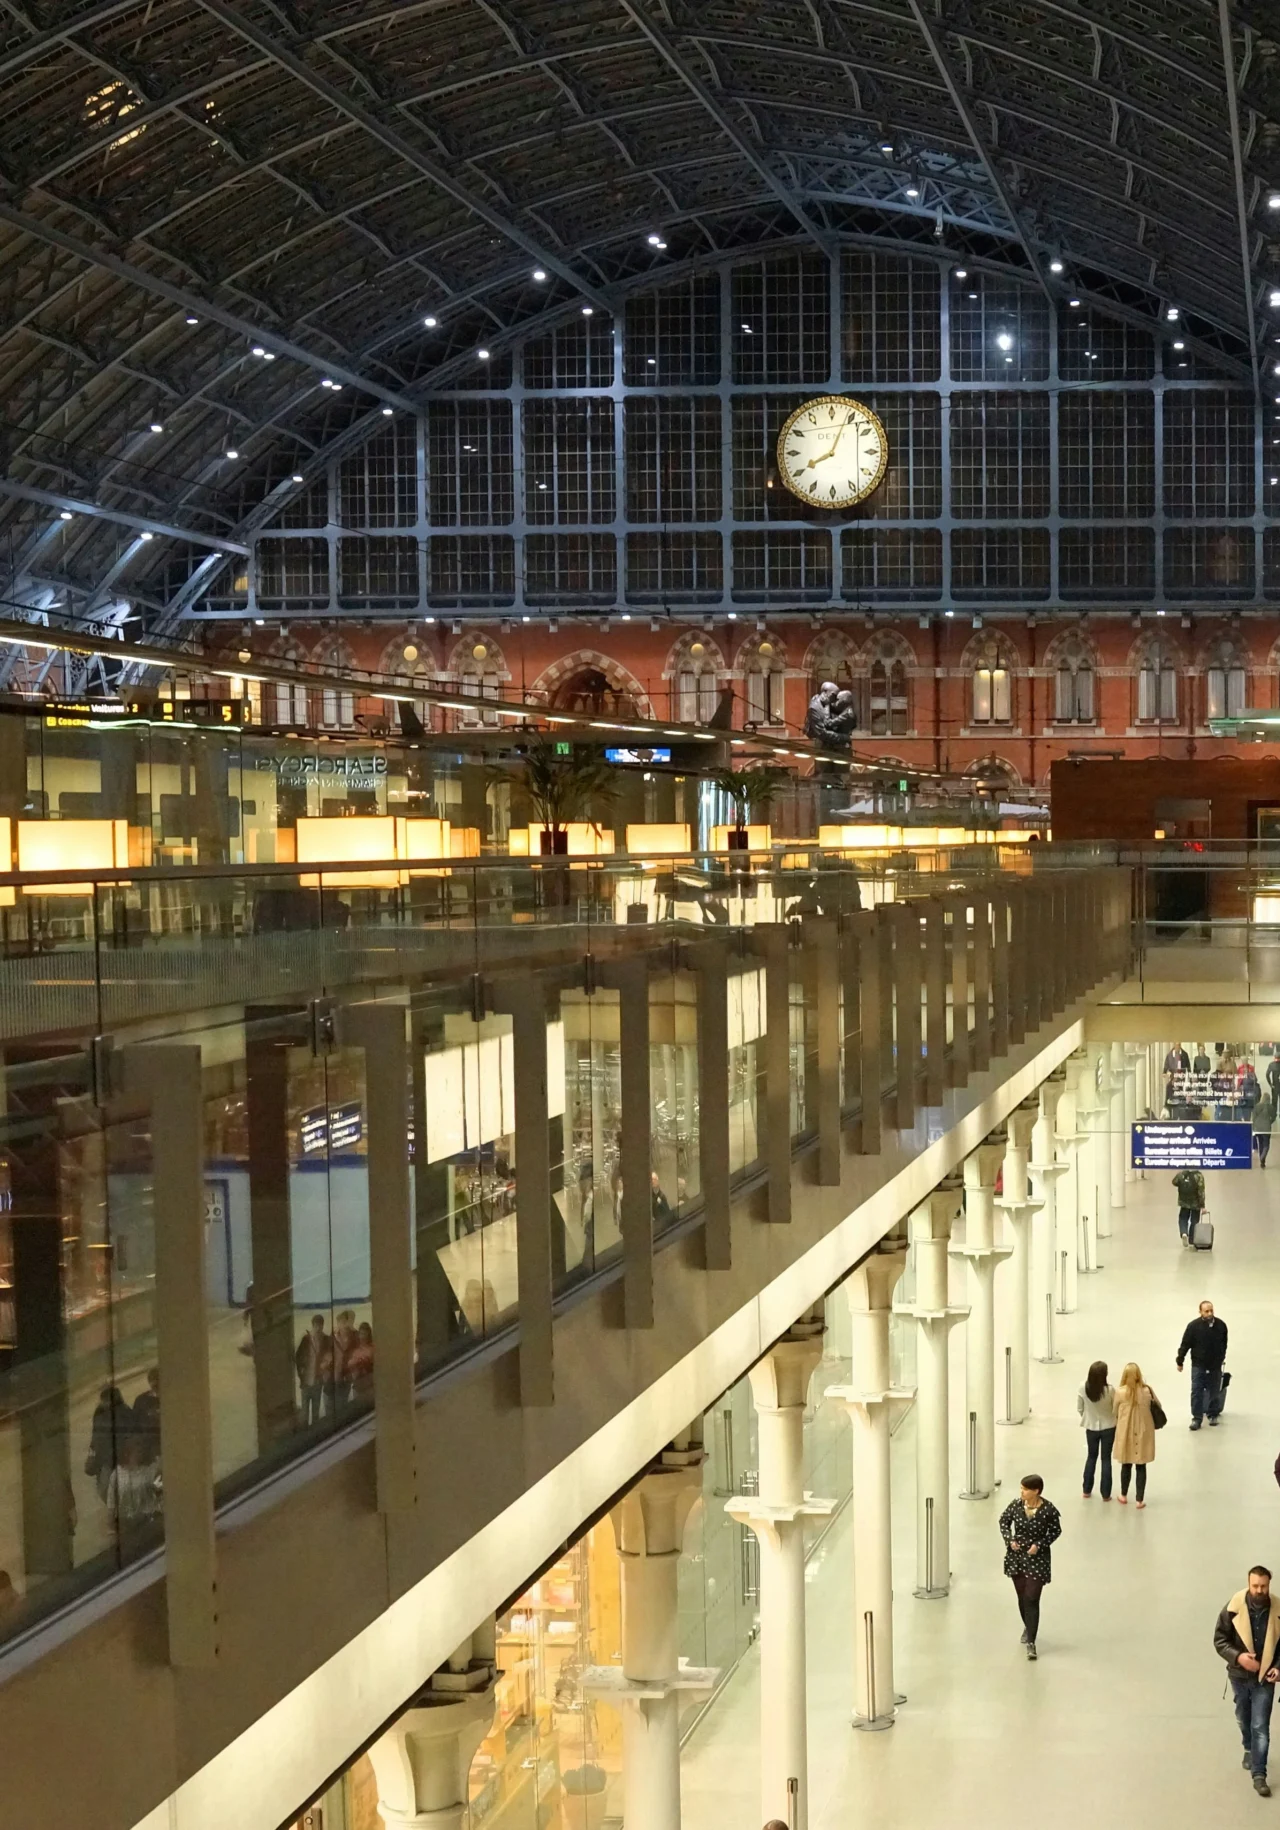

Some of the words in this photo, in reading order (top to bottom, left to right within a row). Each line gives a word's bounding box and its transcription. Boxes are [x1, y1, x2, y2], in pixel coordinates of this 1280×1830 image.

[221, 705, 232, 722] 5
[1192, 1136, 1217, 1145] Arrivées
[1204, 1147, 1223, 1155] Billets
[1202, 1158, 1226, 1167] Départs
